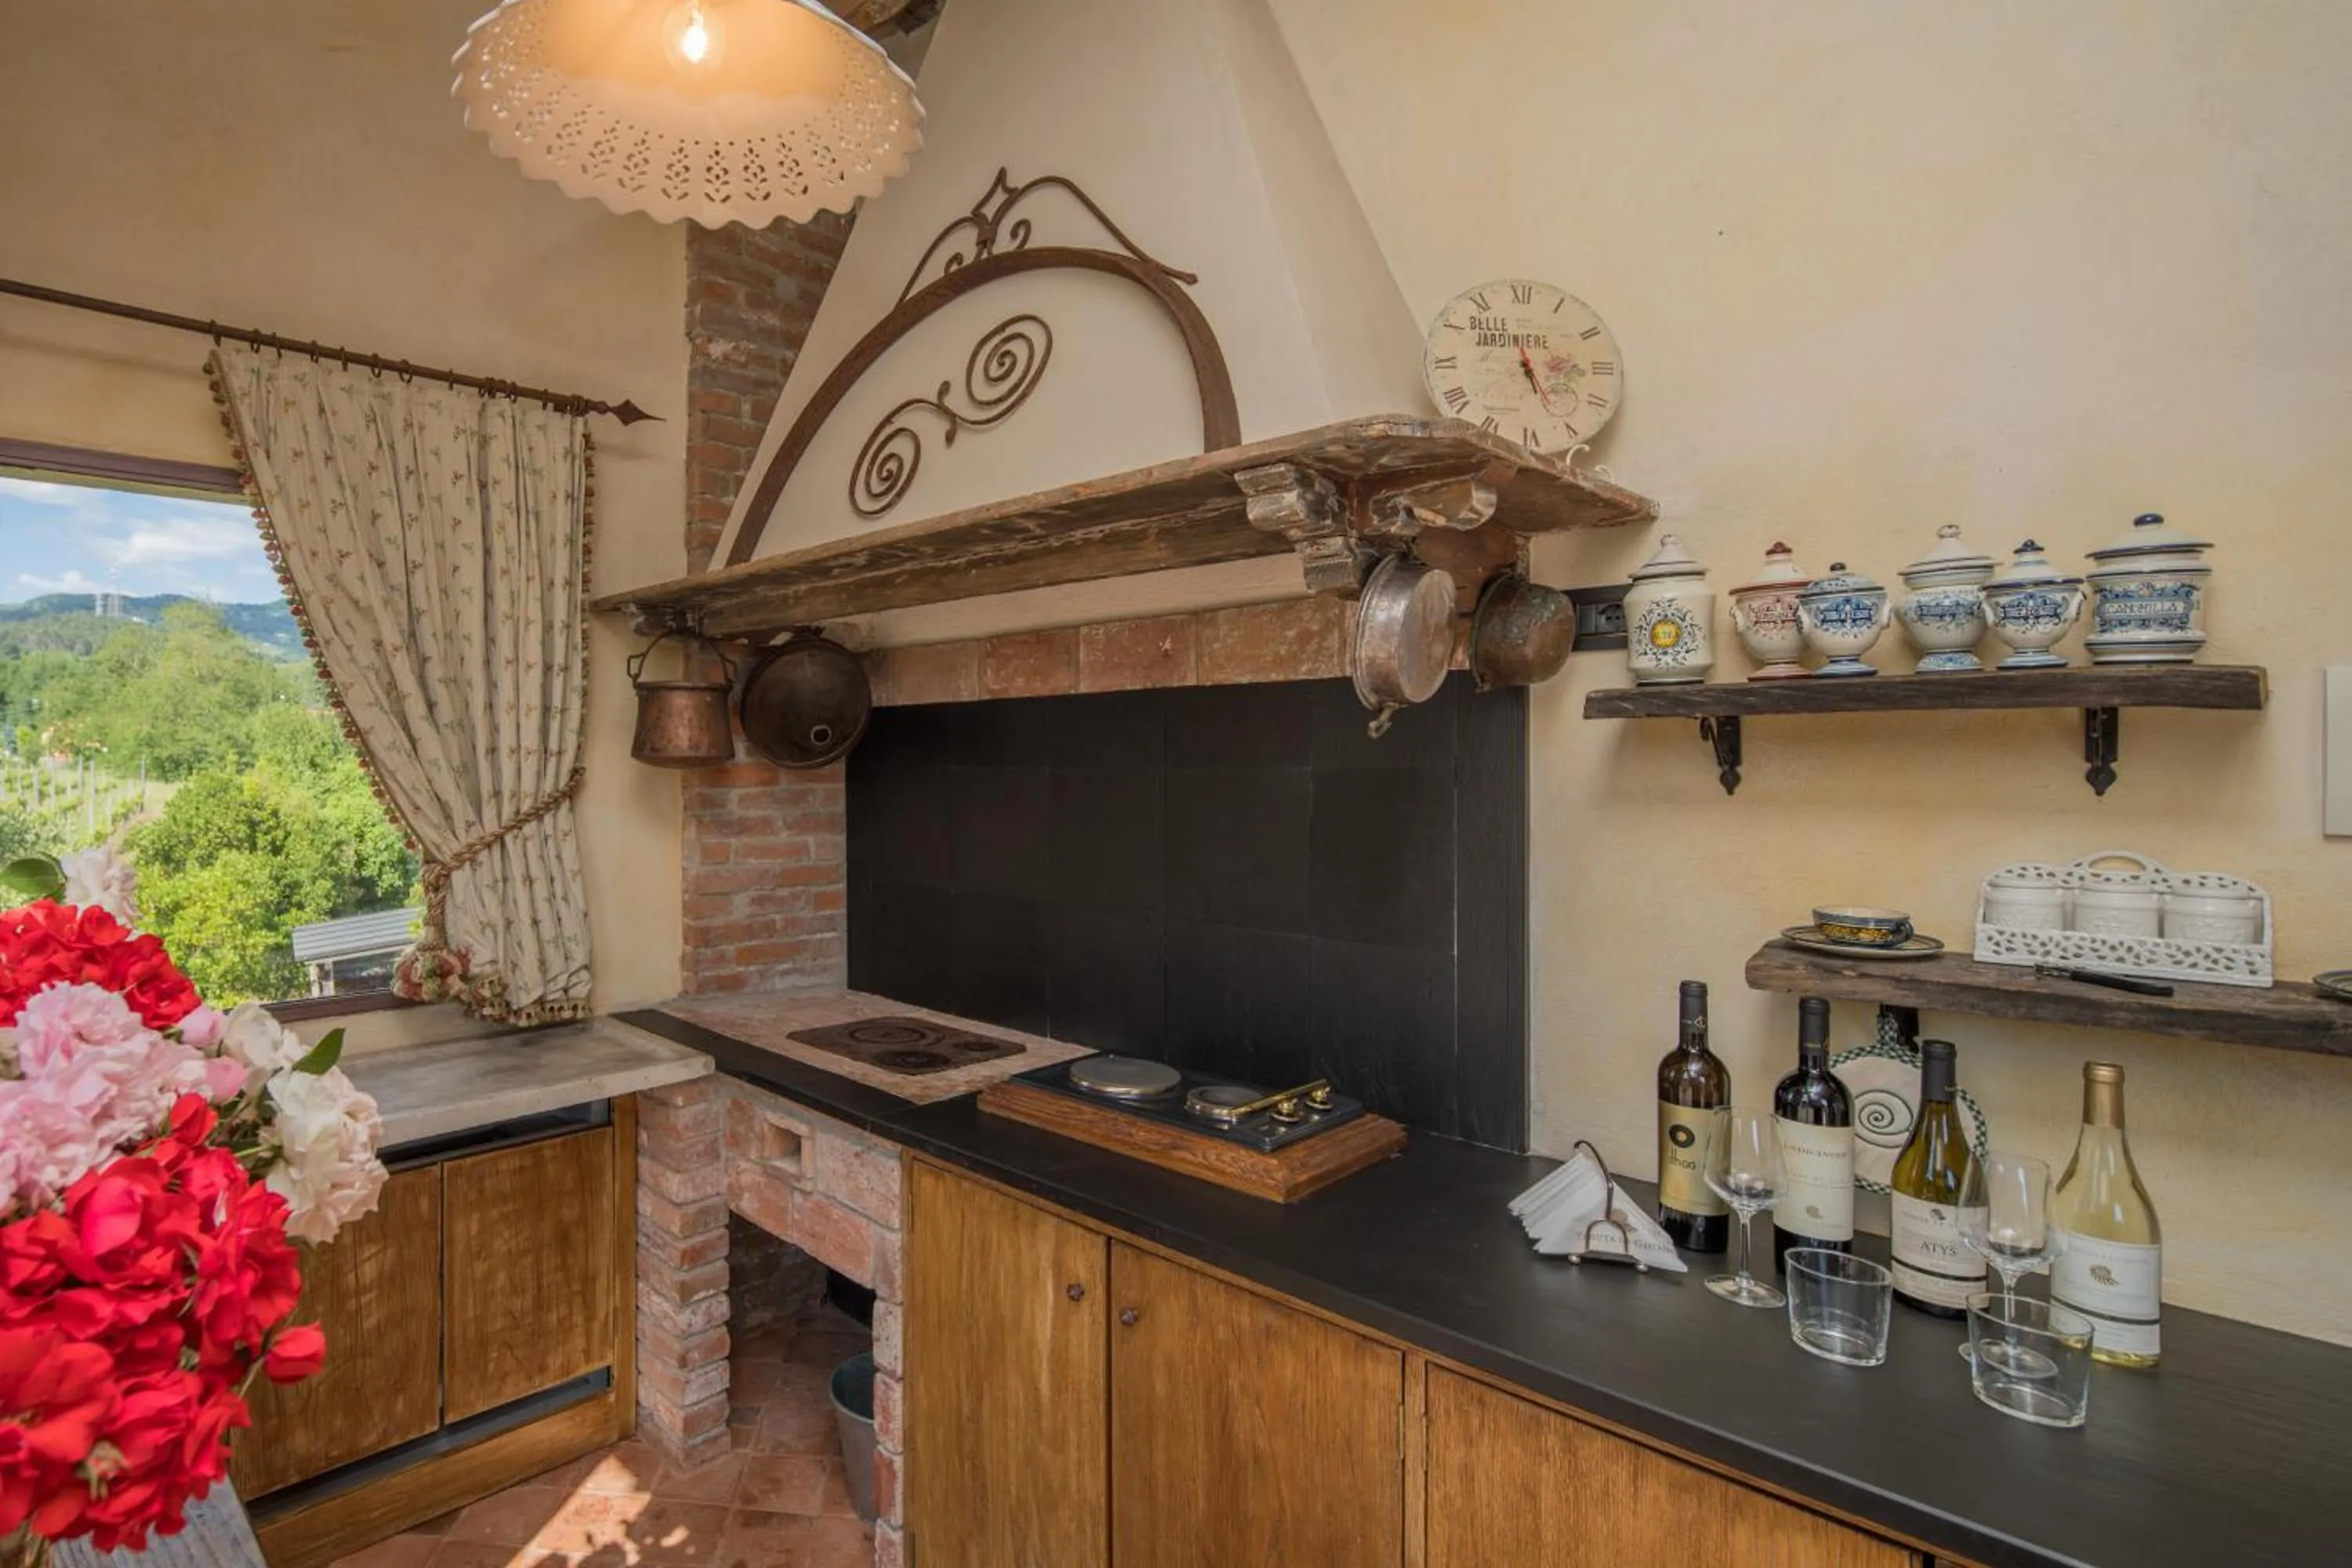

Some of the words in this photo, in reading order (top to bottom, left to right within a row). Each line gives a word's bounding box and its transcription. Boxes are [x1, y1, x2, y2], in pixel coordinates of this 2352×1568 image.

[1510, 284, 1533, 305] XII
[1469, 316, 1508, 332] BELLE
[1475, 333, 1550, 350] JARDINIERE
[1579, 326, 1601, 341] II
[1591, 361, 1614, 376] III
